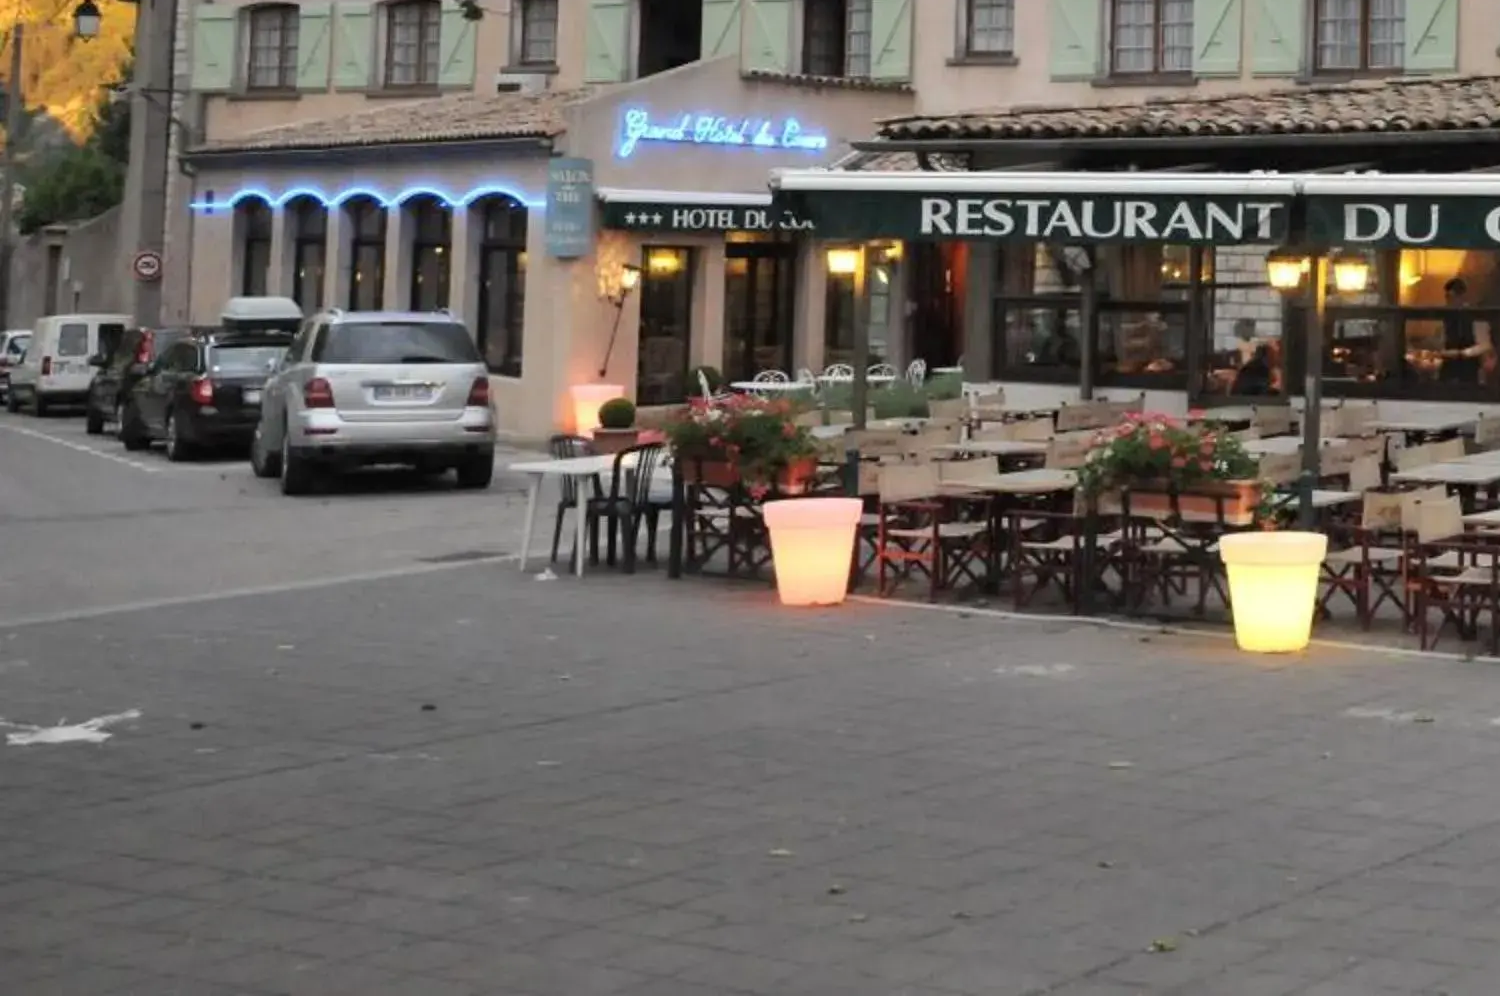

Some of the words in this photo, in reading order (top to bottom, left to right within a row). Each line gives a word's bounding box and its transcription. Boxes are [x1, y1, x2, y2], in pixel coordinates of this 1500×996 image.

[671, 208, 738, 230] HOTEL
[919, 198, 1285, 240] RESTAURANT
[1342, 202, 1440, 242] DU
